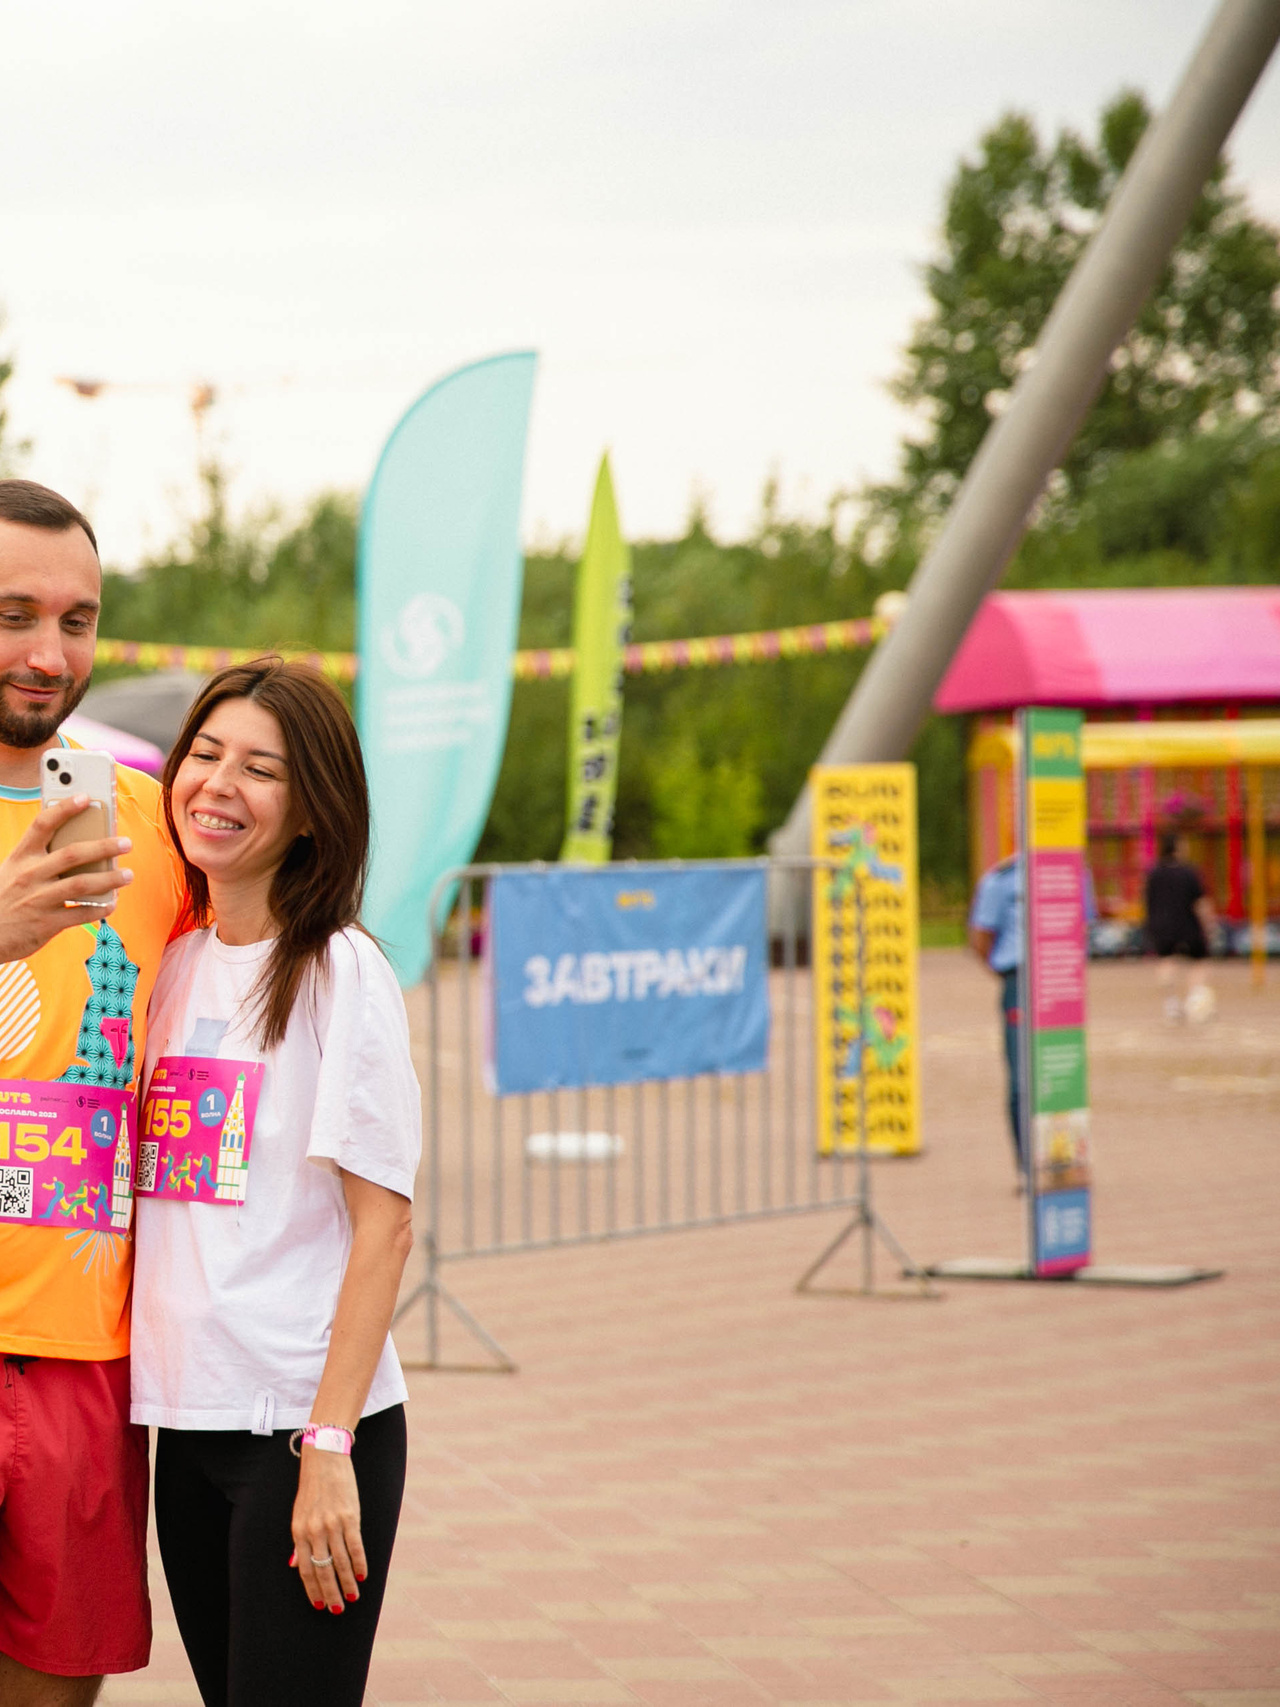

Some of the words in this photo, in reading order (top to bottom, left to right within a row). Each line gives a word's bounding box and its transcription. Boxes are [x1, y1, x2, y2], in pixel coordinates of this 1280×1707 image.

[523, 944, 749, 1008] ЗАВТРАКИ
[206, 1094, 216, 1111] 1
[38, 1110, 58, 1119] 2023
[145, 1098, 192, 1138] 155
[100, 1115, 109, 1132] 1
